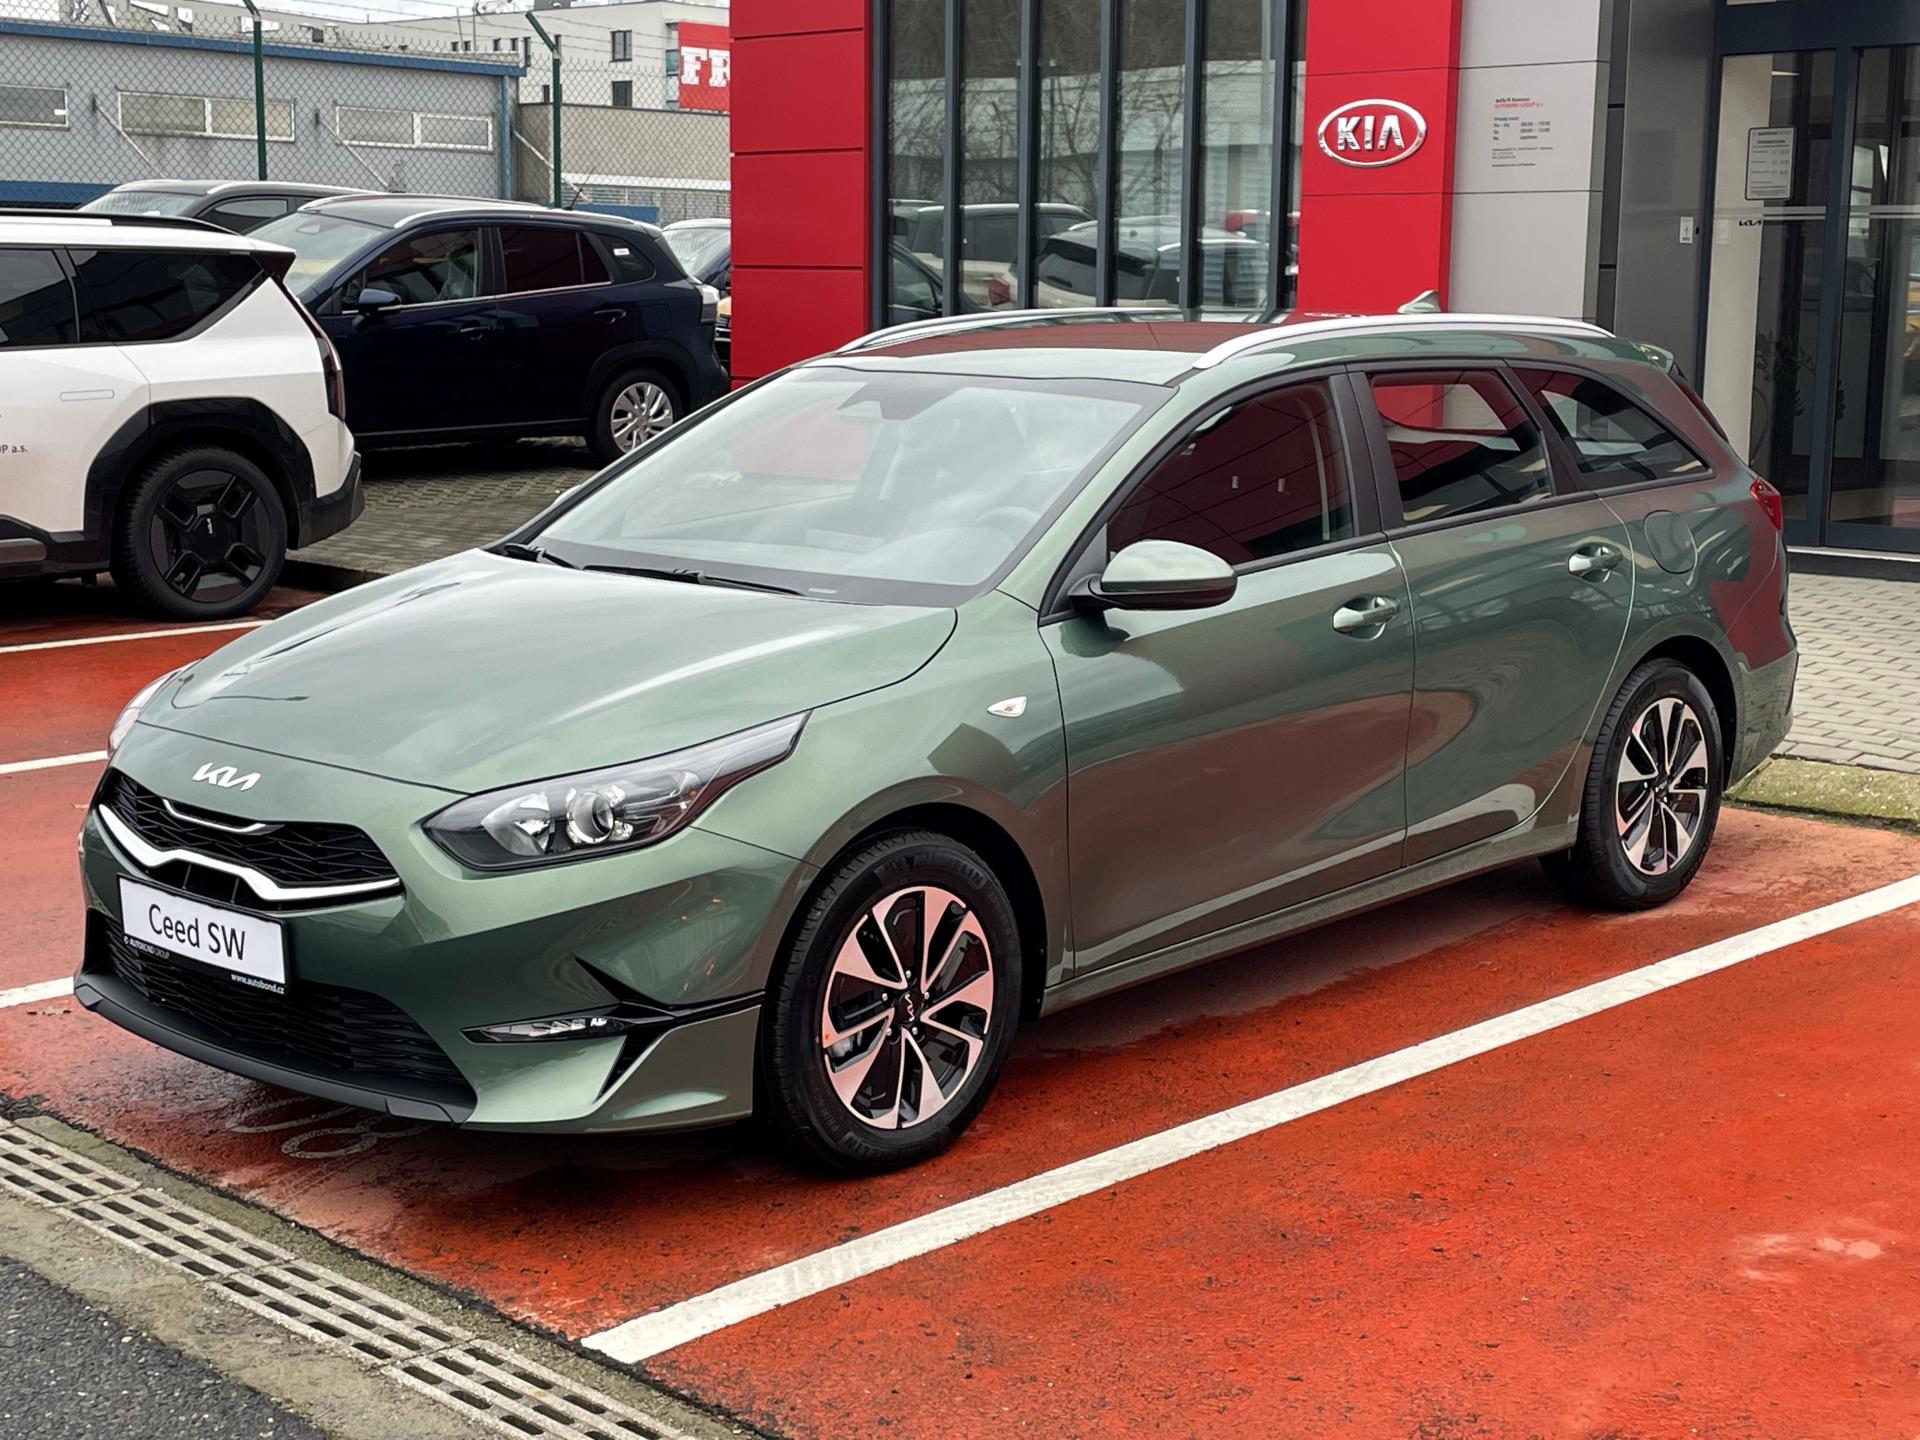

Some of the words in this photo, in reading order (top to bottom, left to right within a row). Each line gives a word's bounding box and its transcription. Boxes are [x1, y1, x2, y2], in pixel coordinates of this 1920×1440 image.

[1337, 114, 1405, 151] KIA
[192, 761, 262, 792] KIA
[148, 903, 201, 949] Ceed
[207, 921, 246, 961] SW
[230, 973, 285, 995] www.autobond.cz
